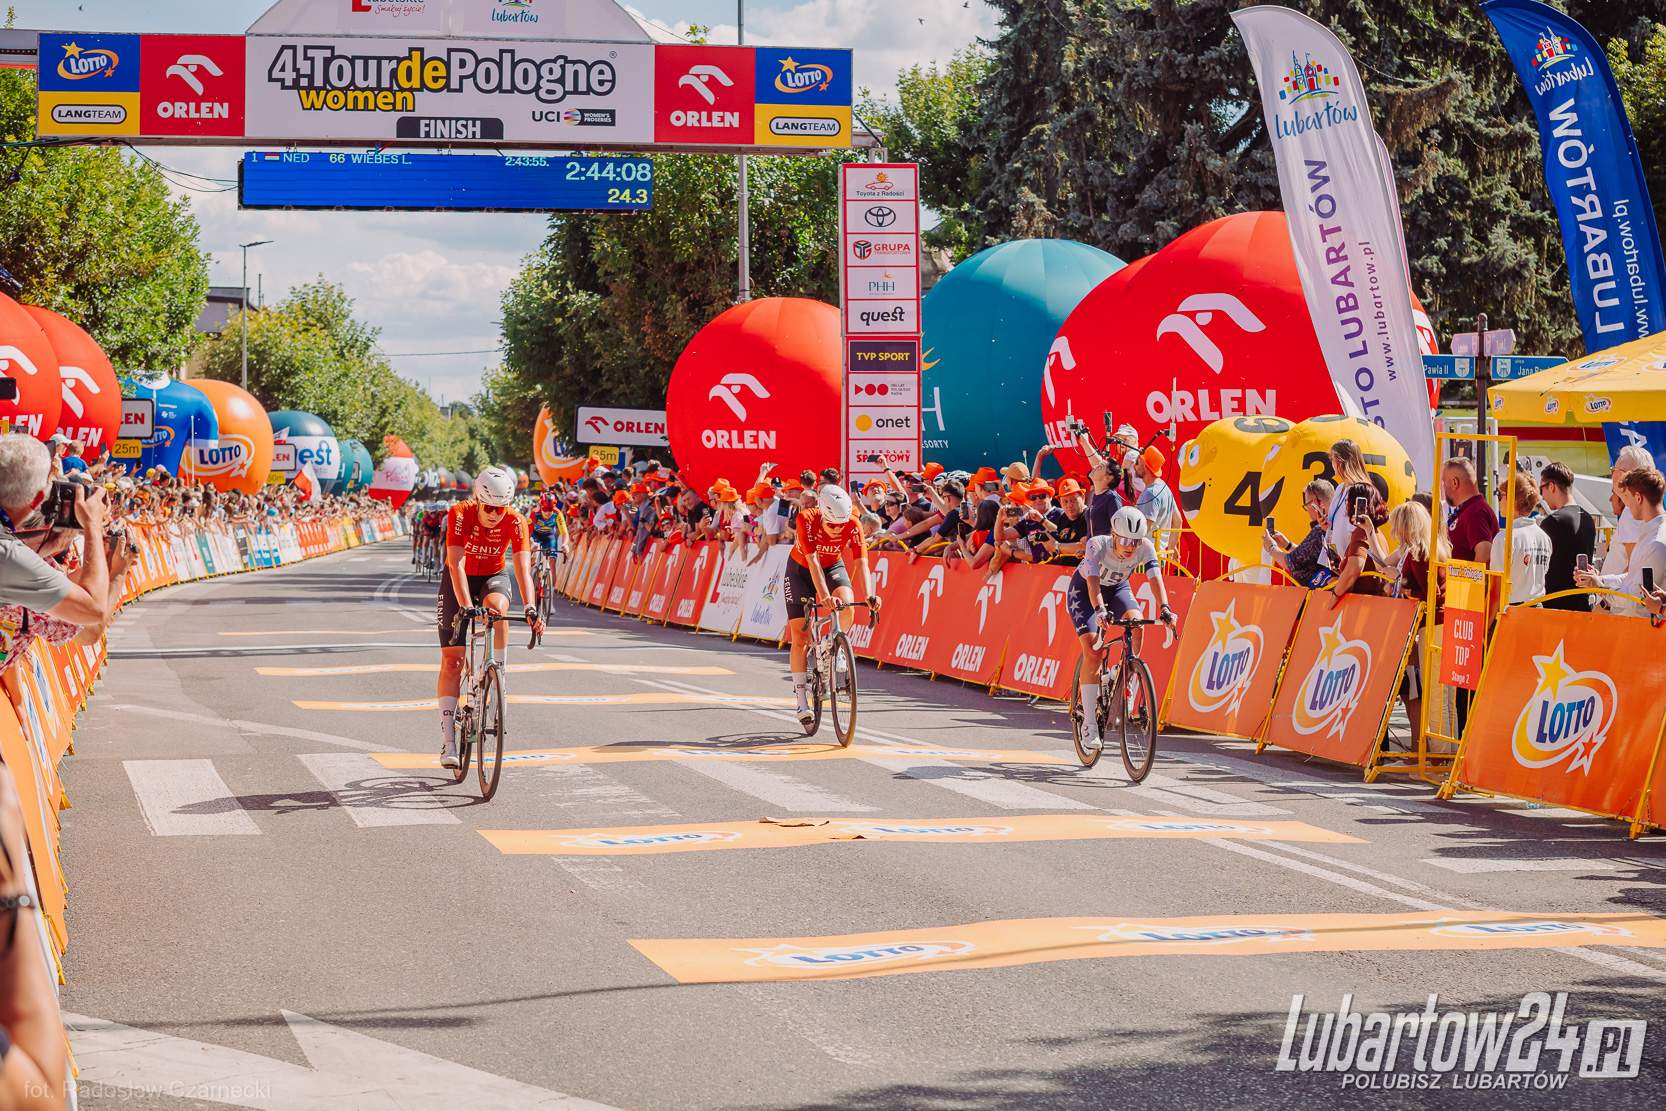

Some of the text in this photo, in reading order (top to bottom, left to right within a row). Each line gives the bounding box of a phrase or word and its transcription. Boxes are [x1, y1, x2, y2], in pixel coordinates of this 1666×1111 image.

[491, 8, 539, 23] Lubartów
[70, 54, 107, 74] LOTTO
[786, 68, 822, 89] LOTTO
[298, 87, 416, 112] women
[57, 109, 122, 120] LANGTEAM
[157, 101, 229, 120] ORLEN
[531, 110, 560, 122] UCI
[670, 111, 739, 128] ORLEN
[1275, 101, 1358, 139] Lubartów
[419, 119, 481, 139] FINISH
[775, 121, 836, 132] LANGTEAM
[251, 153, 258, 162] 1
[283, 153, 310, 163] NED
[329, 153, 345, 164] 66
[351, 154, 399, 164] WIEBES
[402, 155, 412, 164] L.
[565, 162, 652, 182] 2:44:08
[607, 188, 648, 204] 24.3
[874, 243, 911, 251] GRUPA
[1303, 159, 1369, 359] LUBARTÓW
[868, 281, 895, 291] PHH
[860, 306, 905, 326] quest
[1358, 240, 1397, 382] www.lubartow.pl
[856, 352, 910, 361] TVP SPORT
[1146, 389, 1277, 423] ORLEN
[1590, 400, 1607, 409] LOTTO
[613, 420, 665, 435] ORLEN
[876, 416, 911, 428] onet
[114, 443, 140, 455] 25m
[701, 429, 777, 449] ORLEN
[199, 445, 241, 465] LOTTO
[298, 440, 332, 466] est
[856, 454, 911, 462] SPTOWY
[1224, 471, 1263, 527] 4
[464, 541, 501, 555] FENIX
[816, 544, 841, 553] ENIX
[1453, 619, 1474, 641] CLUB
[895, 633, 930, 661] ORLEN
[1455, 645, 1470, 666] TOP
[951, 643, 986, 672] ORLEN
[1013, 653, 1060, 688] ORLEN
[1206, 646, 1250, 691] LOTTO
[1451, 671, 1470, 684] Stage 2
[1309, 663, 1356, 711] LOTTO
[1536, 695, 1596, 744] LOTTO
[792, 944, 925, 964] LOTTO
